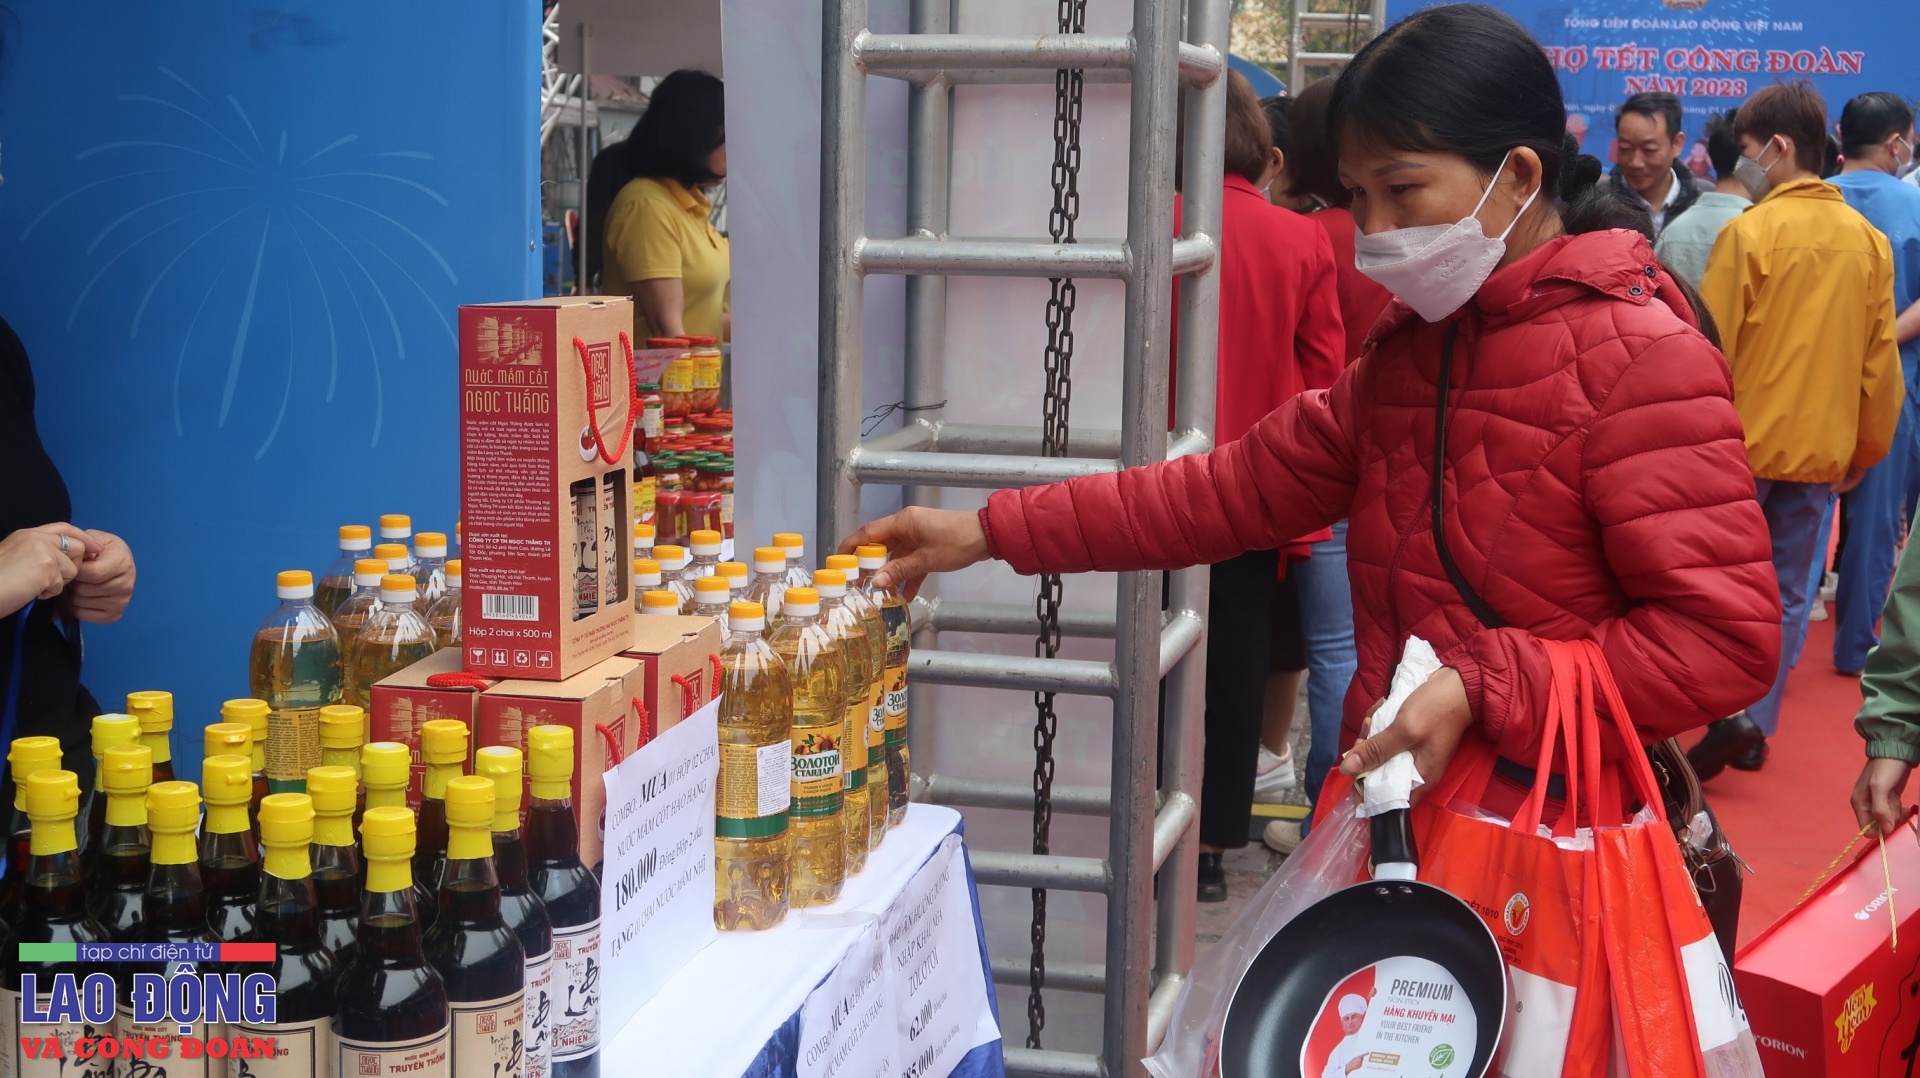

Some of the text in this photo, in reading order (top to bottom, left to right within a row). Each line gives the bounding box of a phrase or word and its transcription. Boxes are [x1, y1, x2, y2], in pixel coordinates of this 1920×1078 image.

[1564, 16, 1803, 33] TỔNG LIÊN ĐOÀN LAO ĐỘNG VIỆT NAM
[1541, 41, 1864, 74] HỢ TẾT CÔNG ĐOÀN
[1624, 73, 1748, 98] NĂM 2023
[530, 368, 548, 384] CỐT
[591, 352, 607, 379] NGỌC
[466, 388, 549, 416] NGỌC THẮNG
[469, 626, 487, 638] Hộp
[488, 628, 494, 636] 2
[496, 629, 514, 637] chai
[523, 629, 540, 638] 500
[542, 630, 552, 638] ml
[790, 752, 840, 770] ЗОЛОТОЙ
[795, 766, 835, 777] СТАНДАРТ
[612, 798, 638, 830] COMBO:
[639, 769, 667, 808] MUA
[676, 758, 691, 780] HỘP
[691, 754, 699, 770] 02
[700, 742, 716, 764] CHAI
[687, 778, 707, 804] HẠNG
[615, 847, 656, 913] 180.000
[1864, 886, 1899, 913] ORION
[1482, 906, 1499, 919] 10/10
[611, 923, 634, 958] TẶNG
[641, 900, 655, 928] CHAI
[1388, 996, 1402, 1004] NON
[1390, 979, 1454, 1001] PREMIUM
[831, 996, 849, 1032] MUA
[1384, 1005, 1406, 1018] HÀNG
[1440, 1013, 1456, 1025] MẠI
[1844, 989, 1866, 1022] New
[910, 999, 933, 1042] 62.000
[1380, 1020, 1433, 1034] YOUR BEST FRIEND
[1840, 1004, 1873, 1054] Year
[1376, 1031, 1420, 1044] IN THE KITCHEN
[1760, 1036, 1805, 1060] ORION
[361, 1056, 378, 1065] NGỌC
[389, 1052, 446, 1074] TRUYỀN THỐNG
